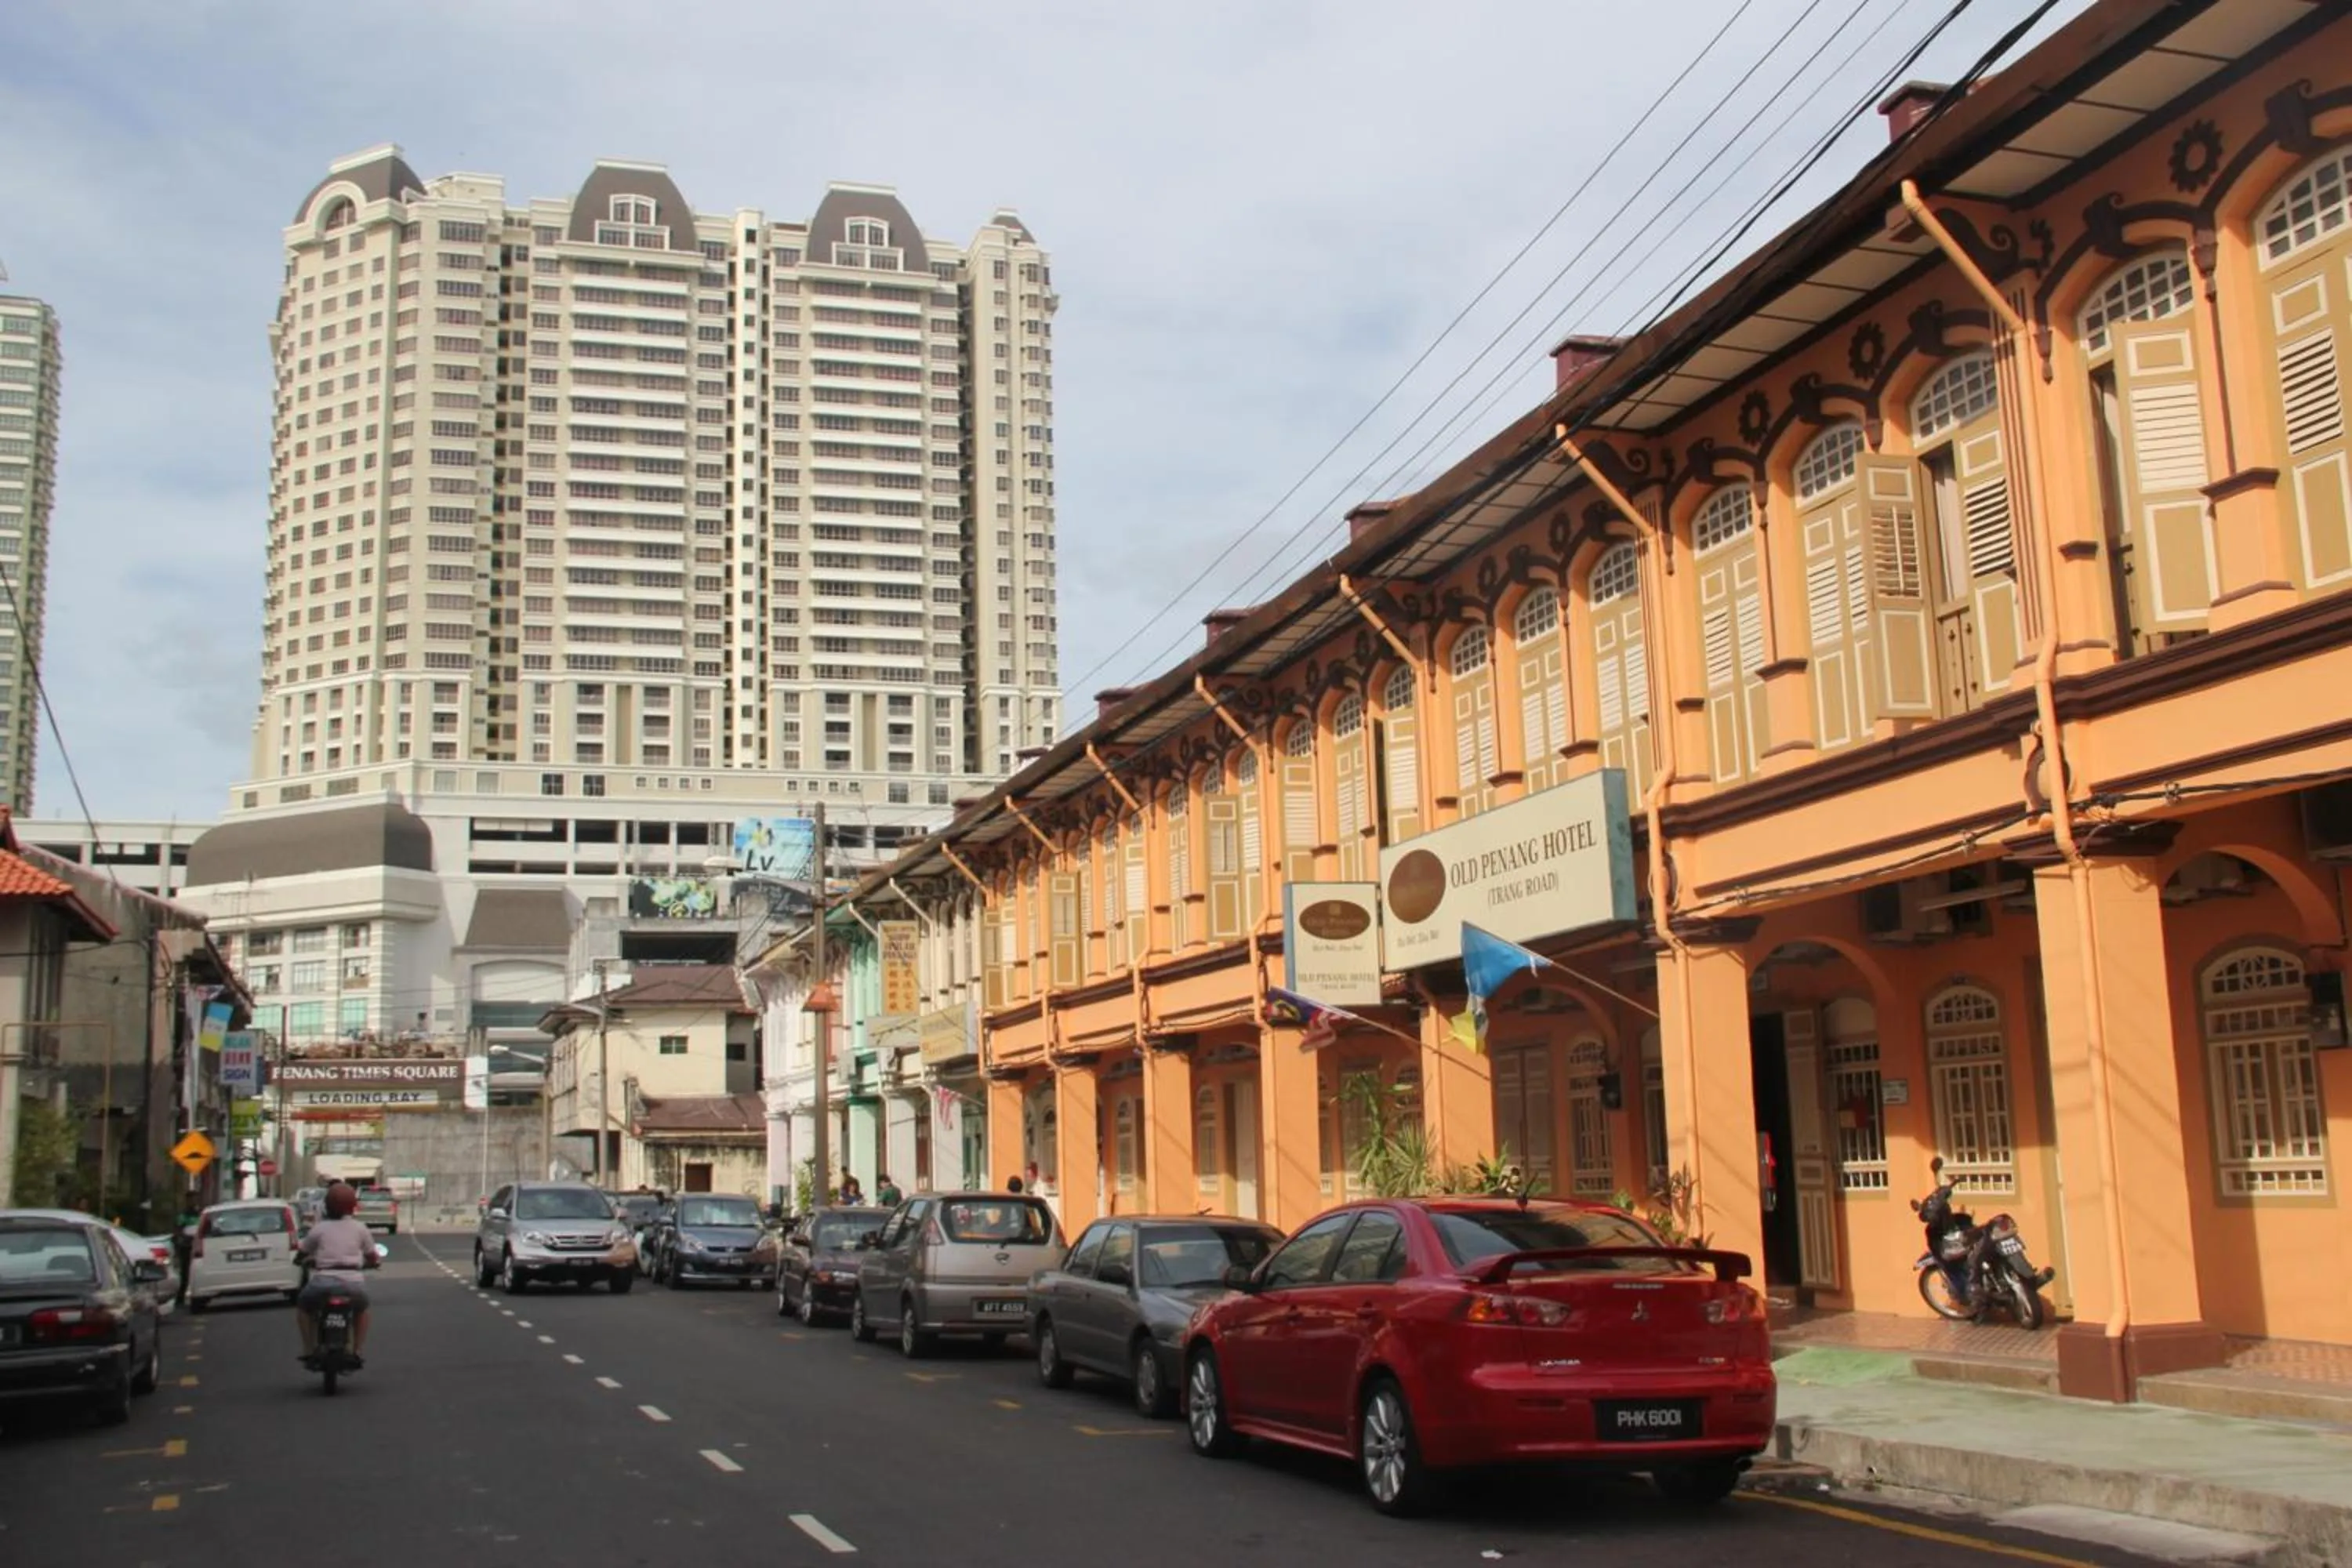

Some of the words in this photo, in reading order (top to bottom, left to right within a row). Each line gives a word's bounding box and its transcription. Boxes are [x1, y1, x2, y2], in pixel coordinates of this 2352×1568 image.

[1450, 856, 1478, 887] OLD
[1481, 838, 1539, 879] PENANG
[1543, 820, 1596, 860] HOTEL
[271, 1066, 339, 1080] PENANG
[342, 1066, 390, 1080] TIMES
[394, 1065, 459, 1081] SQUARE
[308, 1093, 383, 1105] LOADING
[388, 1092, 422, 1102] BAY
[1617, 1410, 1647, 1426] PHK
